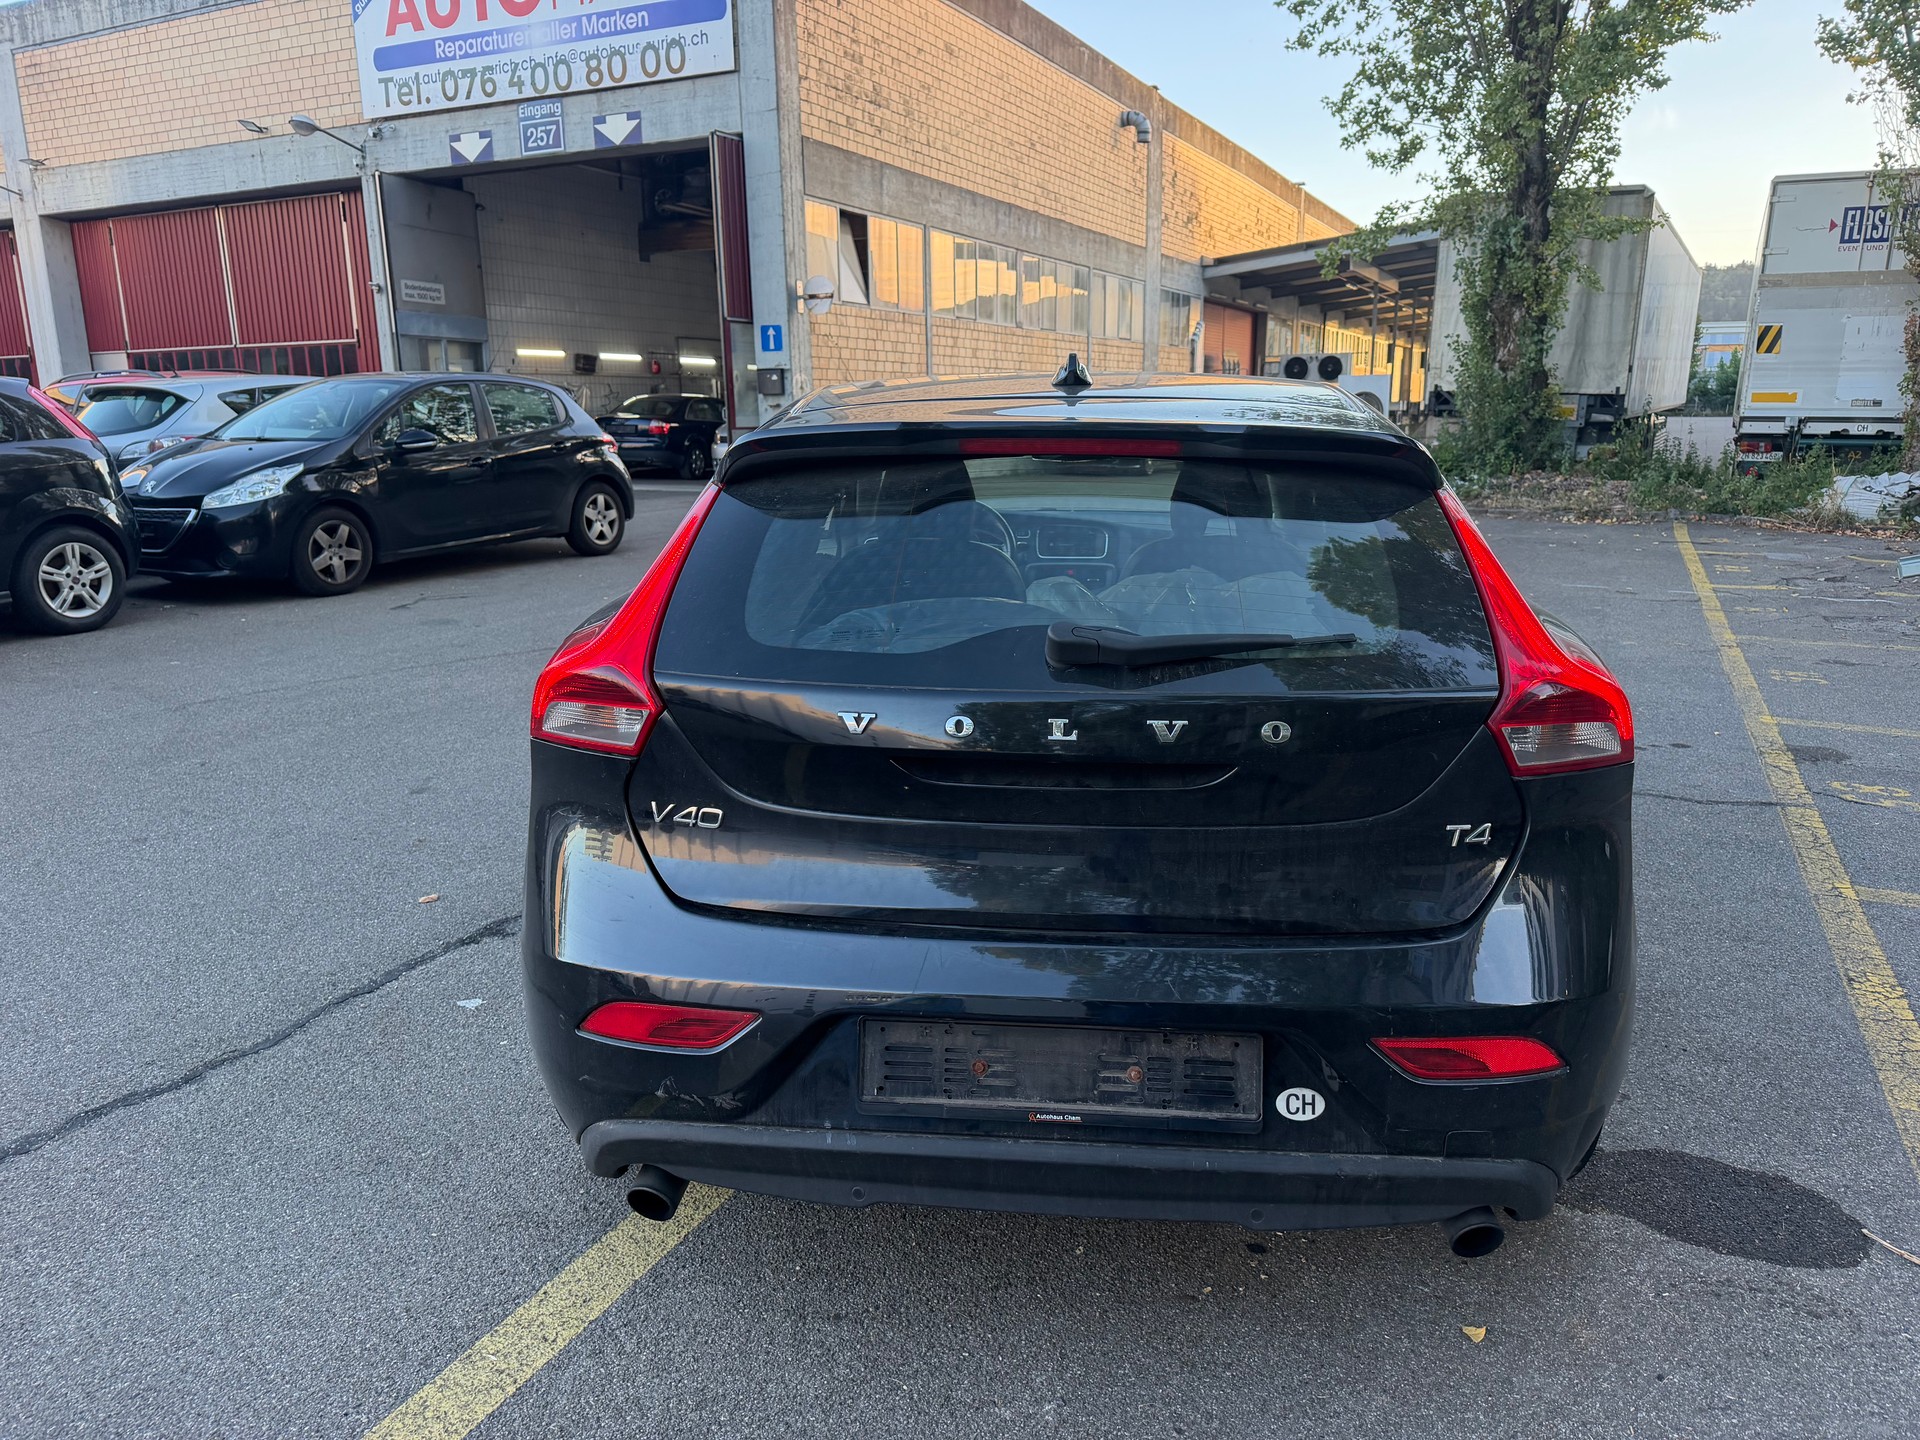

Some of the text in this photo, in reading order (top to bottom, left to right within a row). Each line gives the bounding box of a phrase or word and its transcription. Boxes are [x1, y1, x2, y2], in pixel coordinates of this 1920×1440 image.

[582, 10, 649, 36] Marken
[378, 37, 686, 108] Tel. 076 400 80 00
[519, 103, 561, 118] Eingang
[527, 124, 557, 148] 257
[1856, 424, 1869, 432] CH
[837, 710, 1293, 745] VOLVO
[651, 800, 723, 829] V40
[1445, 823, 1492, 847] T4
[1285, 1092, 1316, 1116] CH
